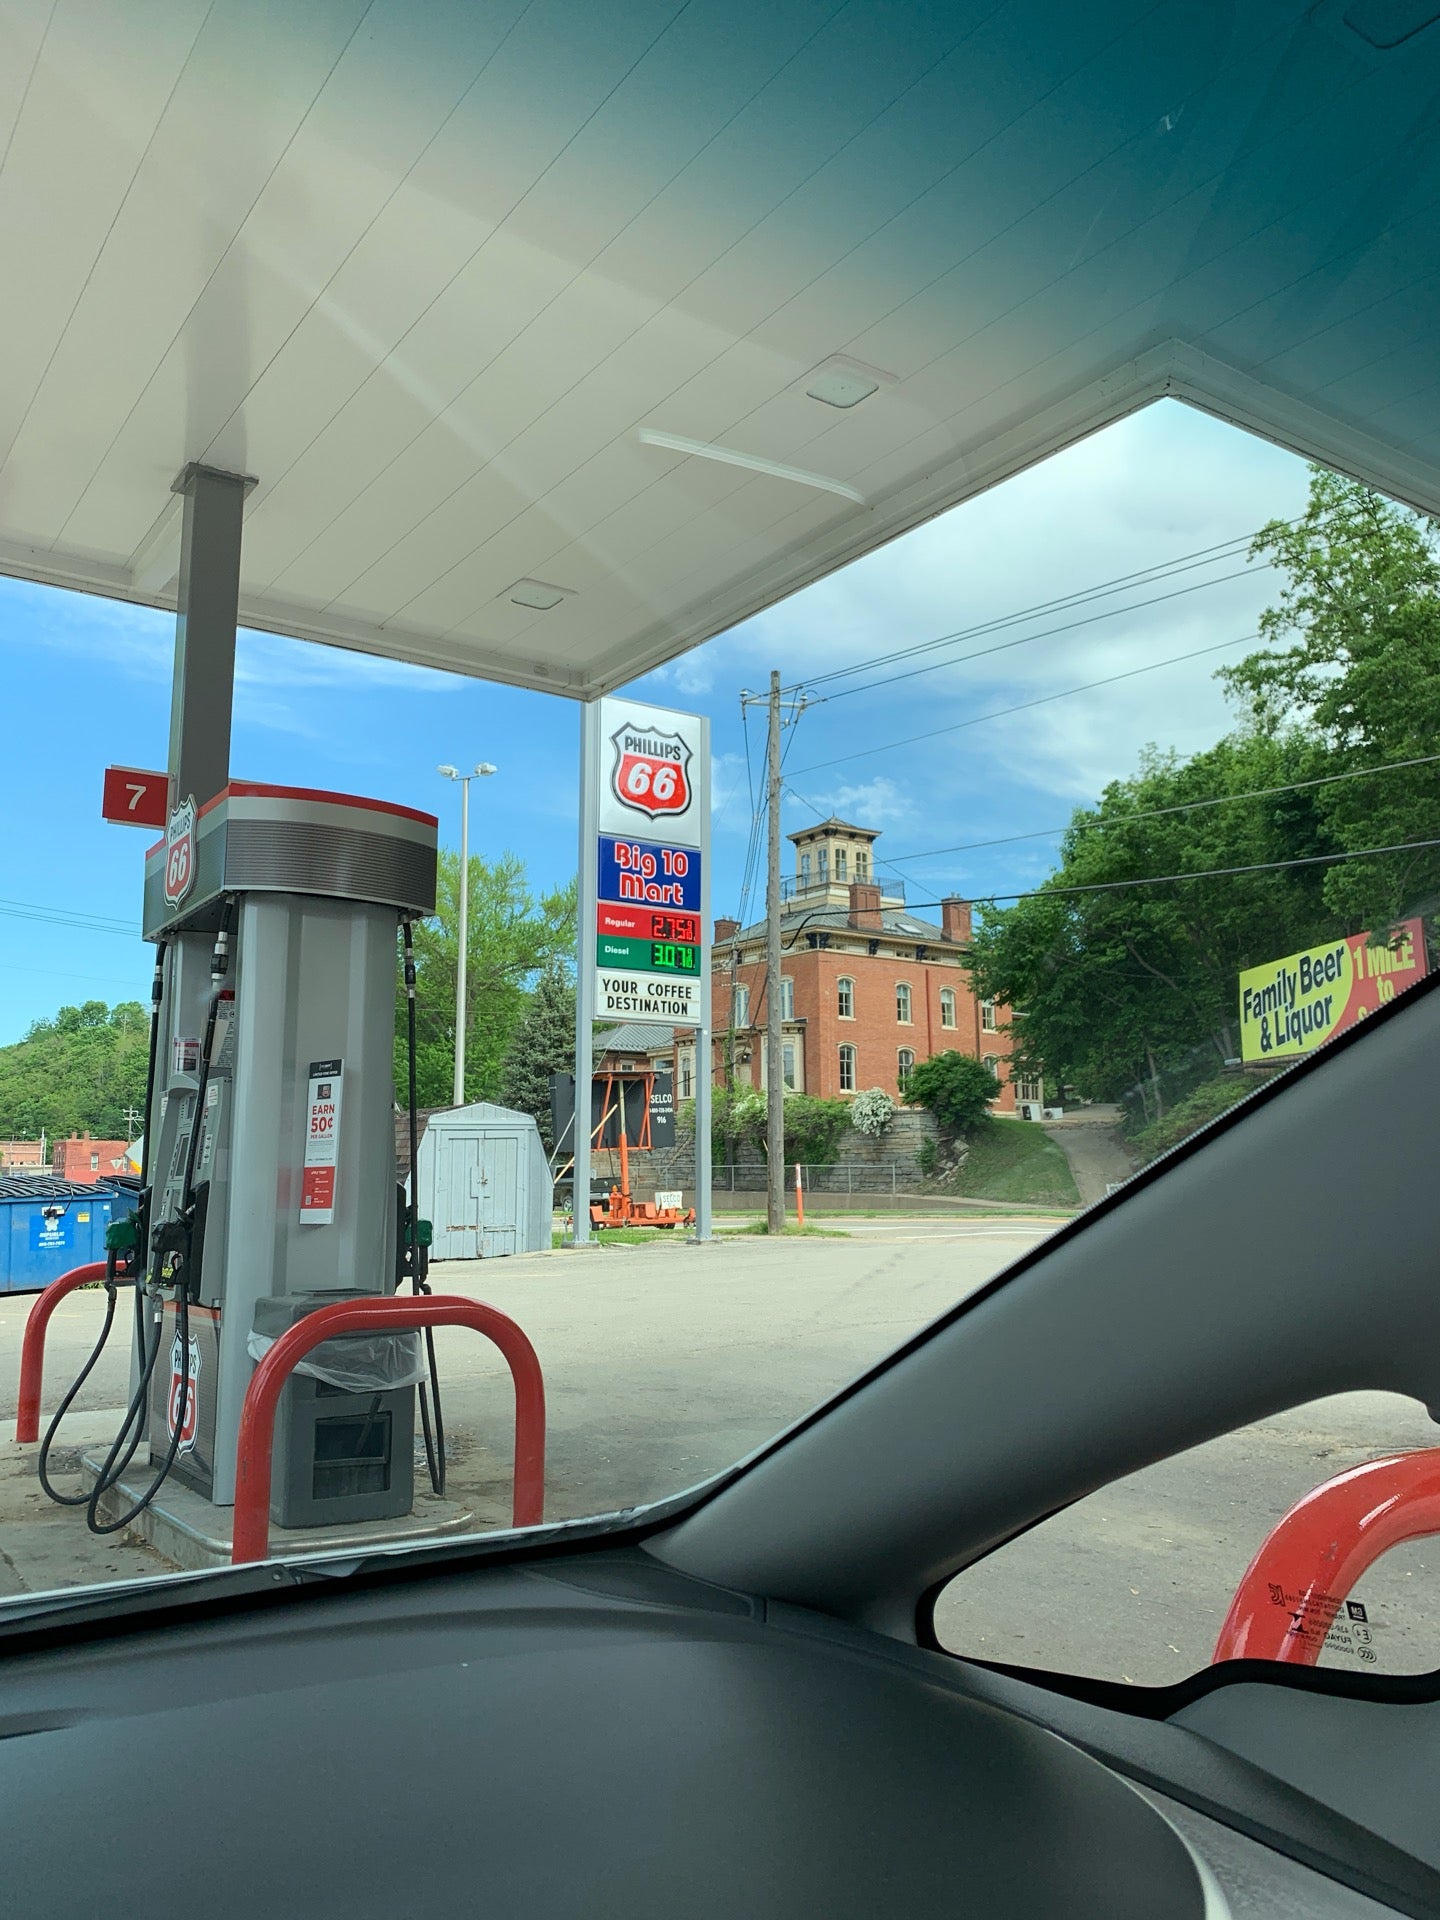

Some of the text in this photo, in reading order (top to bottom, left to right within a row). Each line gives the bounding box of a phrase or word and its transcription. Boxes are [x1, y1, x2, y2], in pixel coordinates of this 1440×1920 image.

[624, 735, 681, 761] PHILLIPS
[627, 762, 678, 801] 66
[125, 783, 147, 810] 7
[170, 812, 191, 842] PHILLIPS
[169, 842, 188, 888] 66
[614, 841, 689, 879] Big 10
[619, 871, 684, 906] Mart
[604, 917, 636, 928] Regular
[604, 945, 630, 955] Diesel
[1353, 931, 1416, 980] 1 MILE
[602, 978, 692, 999] YOUR COFFEE
[1243, 945, 1345, 1024] Family Beer
[1376, 976, 1395, 1003] to
[607, 996, 688, 1015] DESTINATION
[1260, 994, 1333, 1053] & Liquor
[312, 1103, 335, 1115] EARN
[650, 1094, 673, 1104] SELCO
[310, 1116, 334, 1133] 50¢
[656, 1115, 667, 1124] 916
[174, 1350, 197, 1375] PHPS
[172, 1381, 194, 1429] 66
